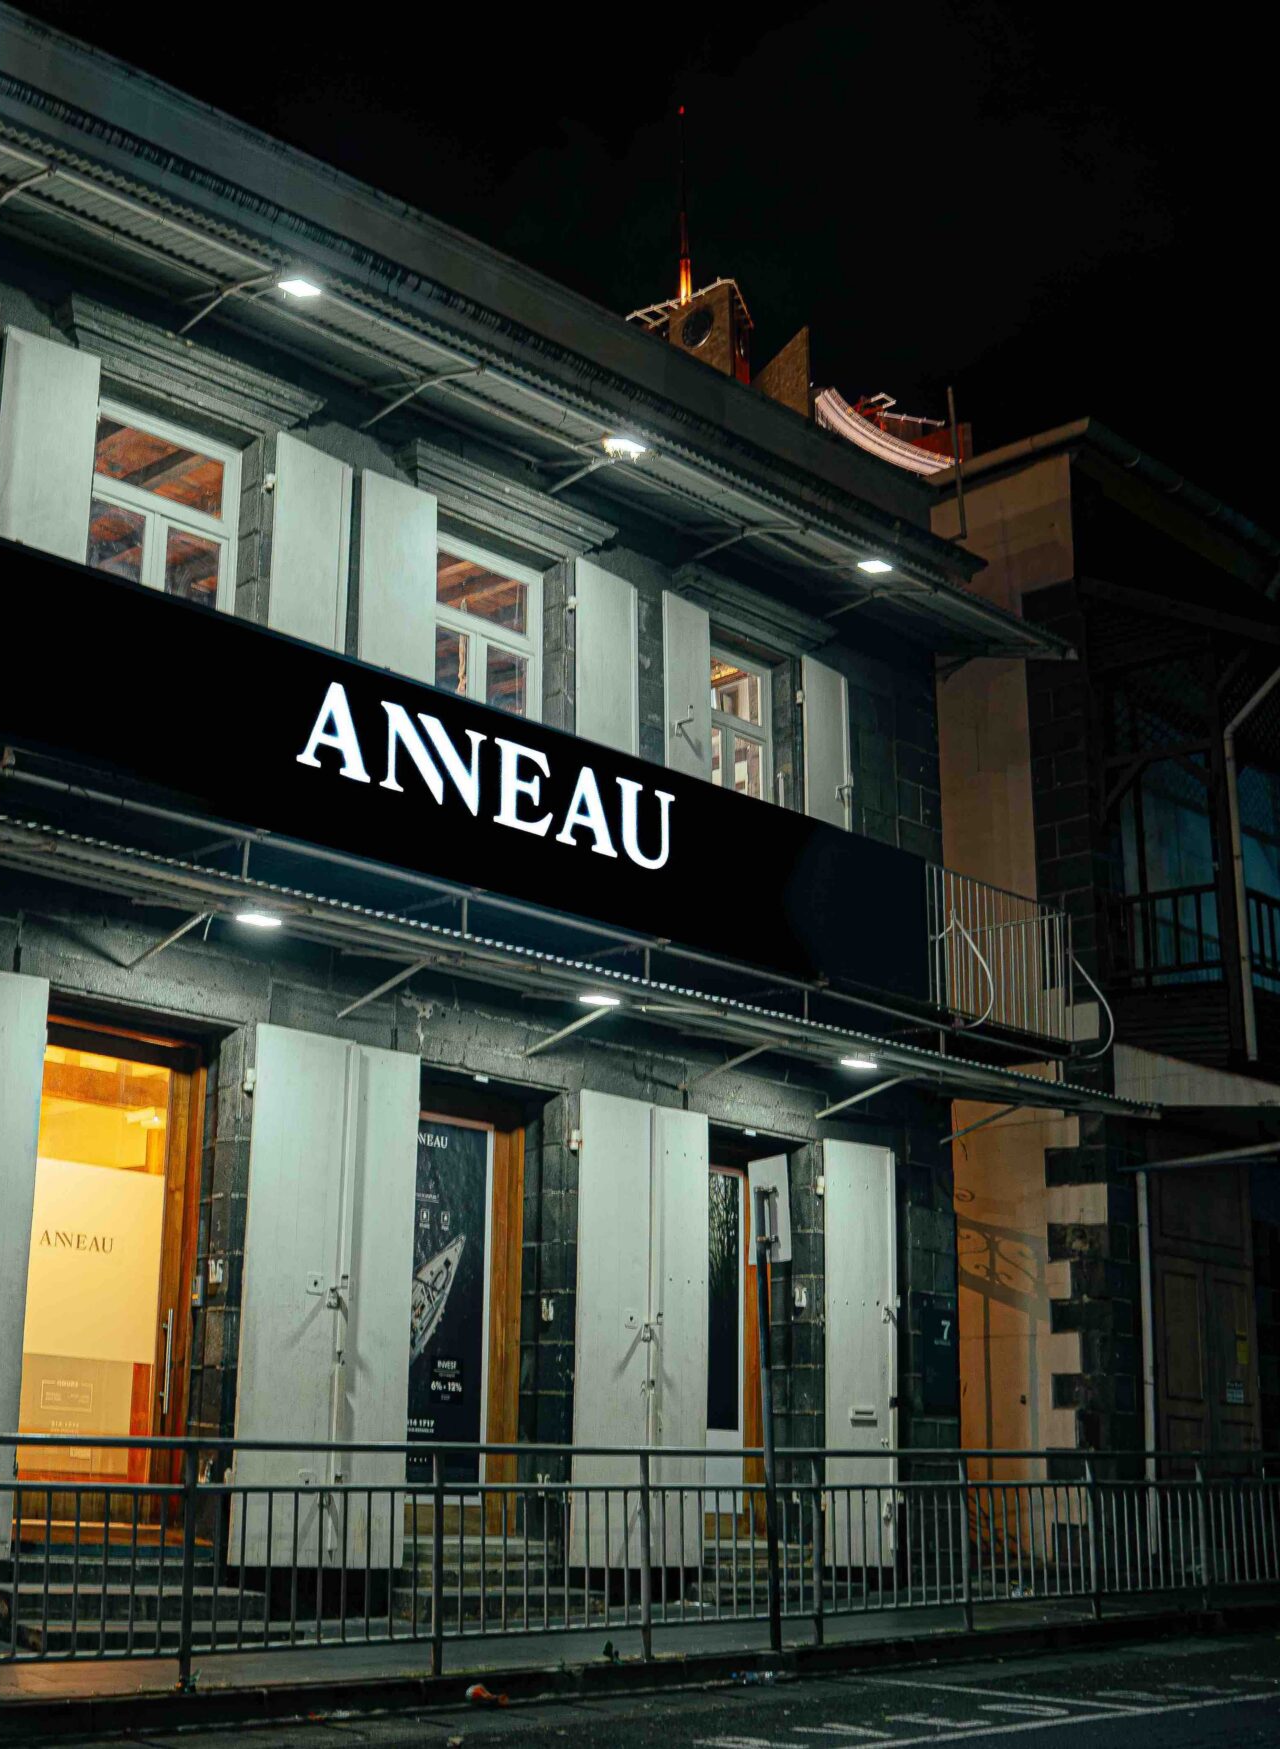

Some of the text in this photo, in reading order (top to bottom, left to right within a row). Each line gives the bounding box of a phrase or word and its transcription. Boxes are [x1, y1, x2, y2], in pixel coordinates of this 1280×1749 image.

[297, 681, 675, 870] ANNEAU
[40, 1230, 113, 1254] ANNEAU
[941, 1319, 951, 1341] 7
